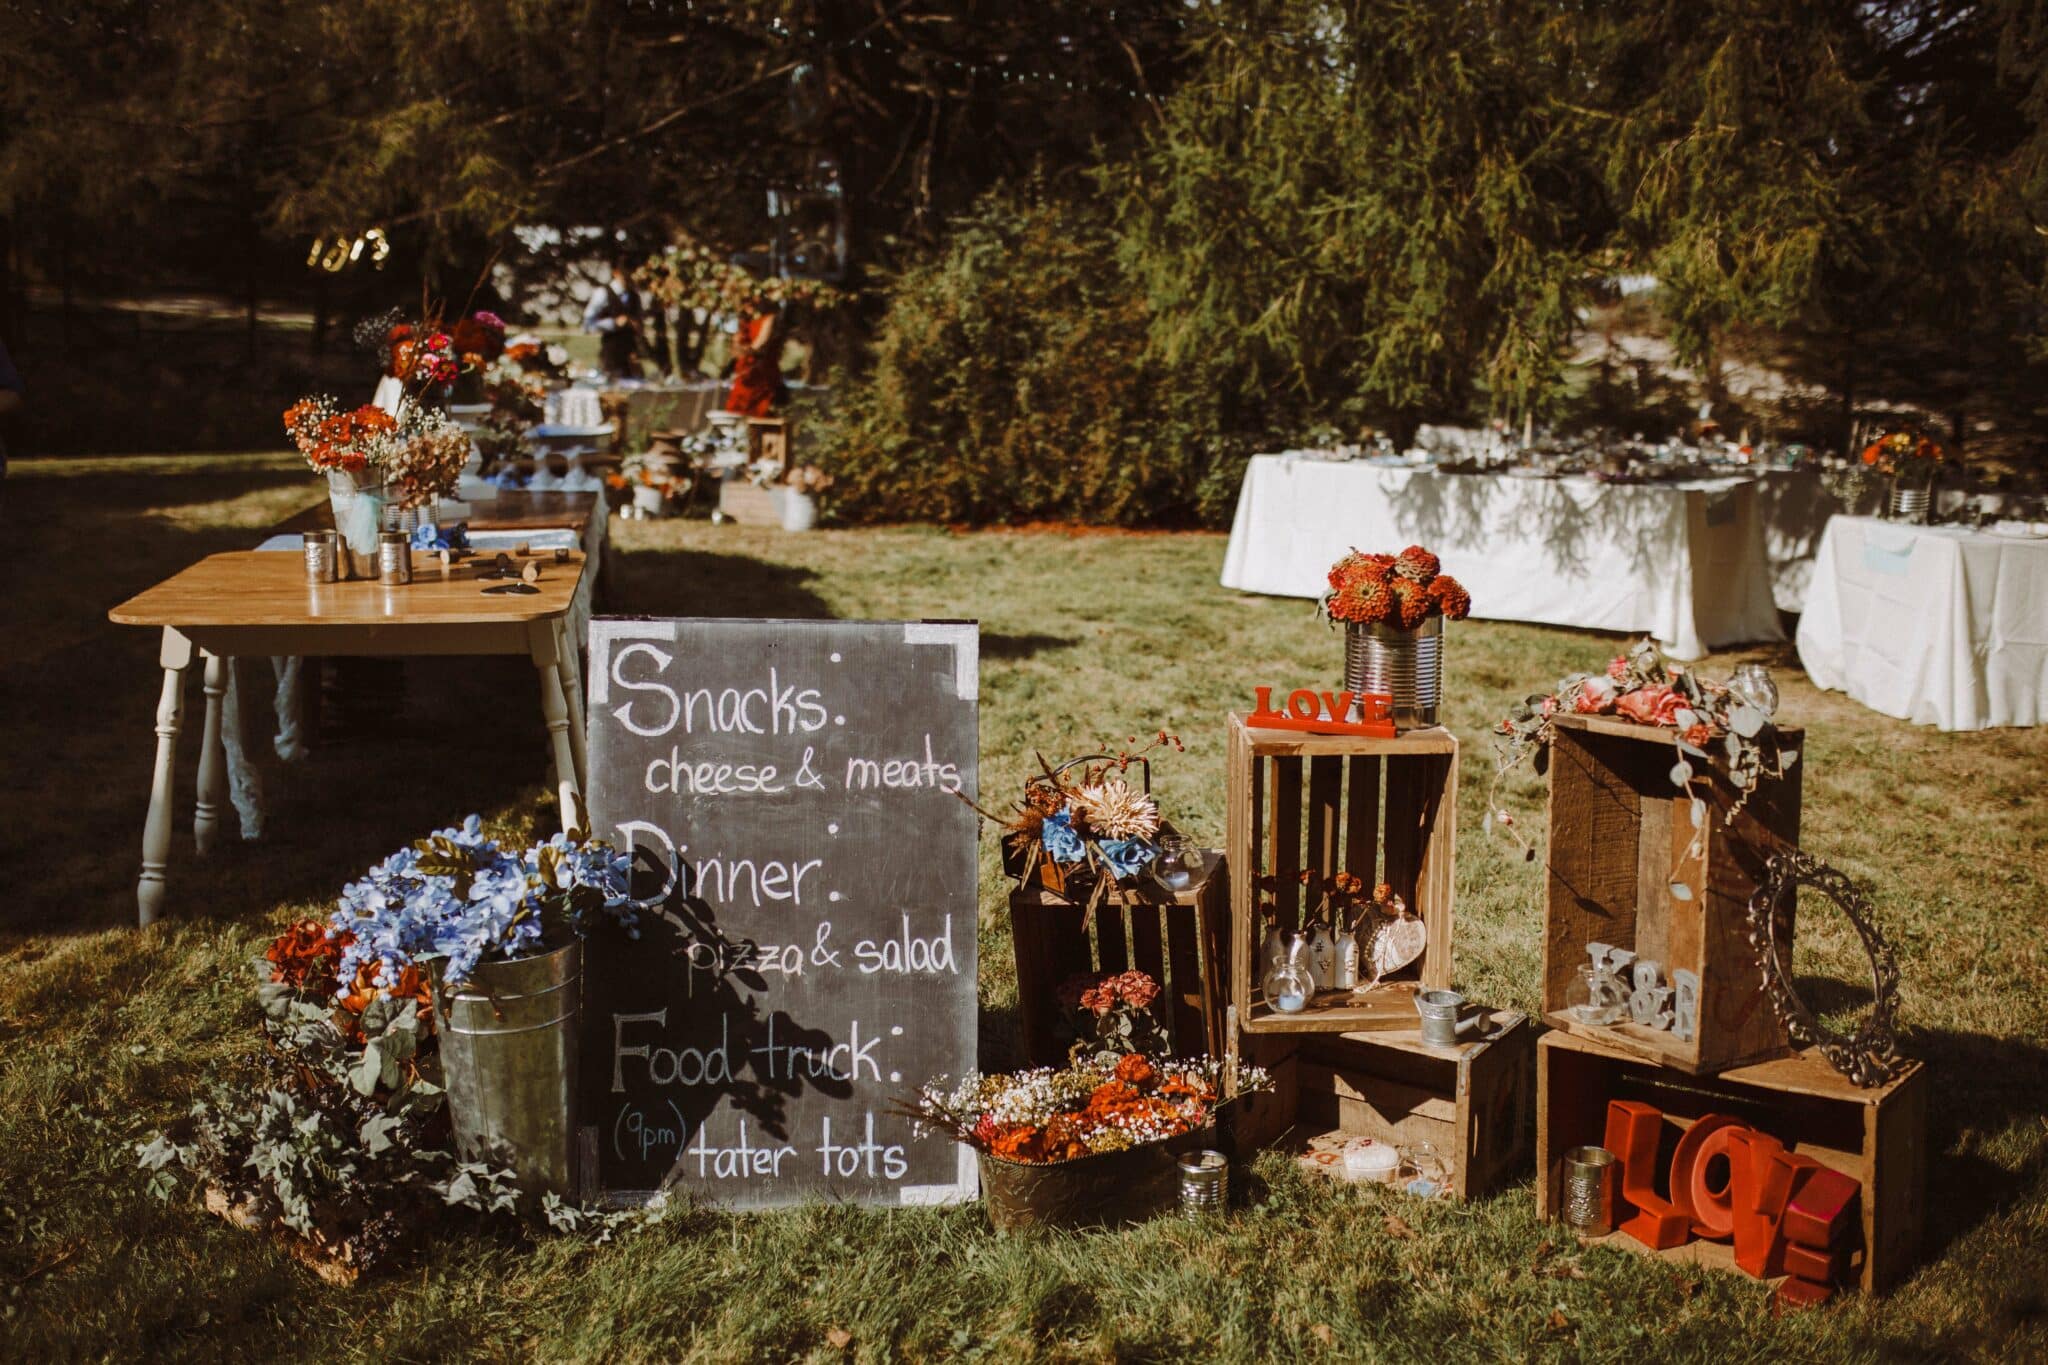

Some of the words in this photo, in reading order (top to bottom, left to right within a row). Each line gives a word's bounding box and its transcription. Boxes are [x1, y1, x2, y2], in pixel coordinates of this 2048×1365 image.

[611, 643, 846, 738] Snacks:
[1253, 685, 1395, 729] LOVE
[645, 745, 786, 796] cheese
[795, 746, 826, 790] &
[845, 733, 962, 794] meats
[615, 820, 840, 908] Dinner:
[686, 929, 806, 999] pizza
[810, 920, 842, 969] &
[854, 912, 959, 976] salad
[610, 1007, 734, 1094] Food
[750, 1012, 904, 1083] truck:
[613, 1098, 687, 1161] (9pm)
[688, 1116, 798, 1179] tater
[816, 1111, 908, 1180] tots
[1603, 1099, 1863, 1310] LOVE
